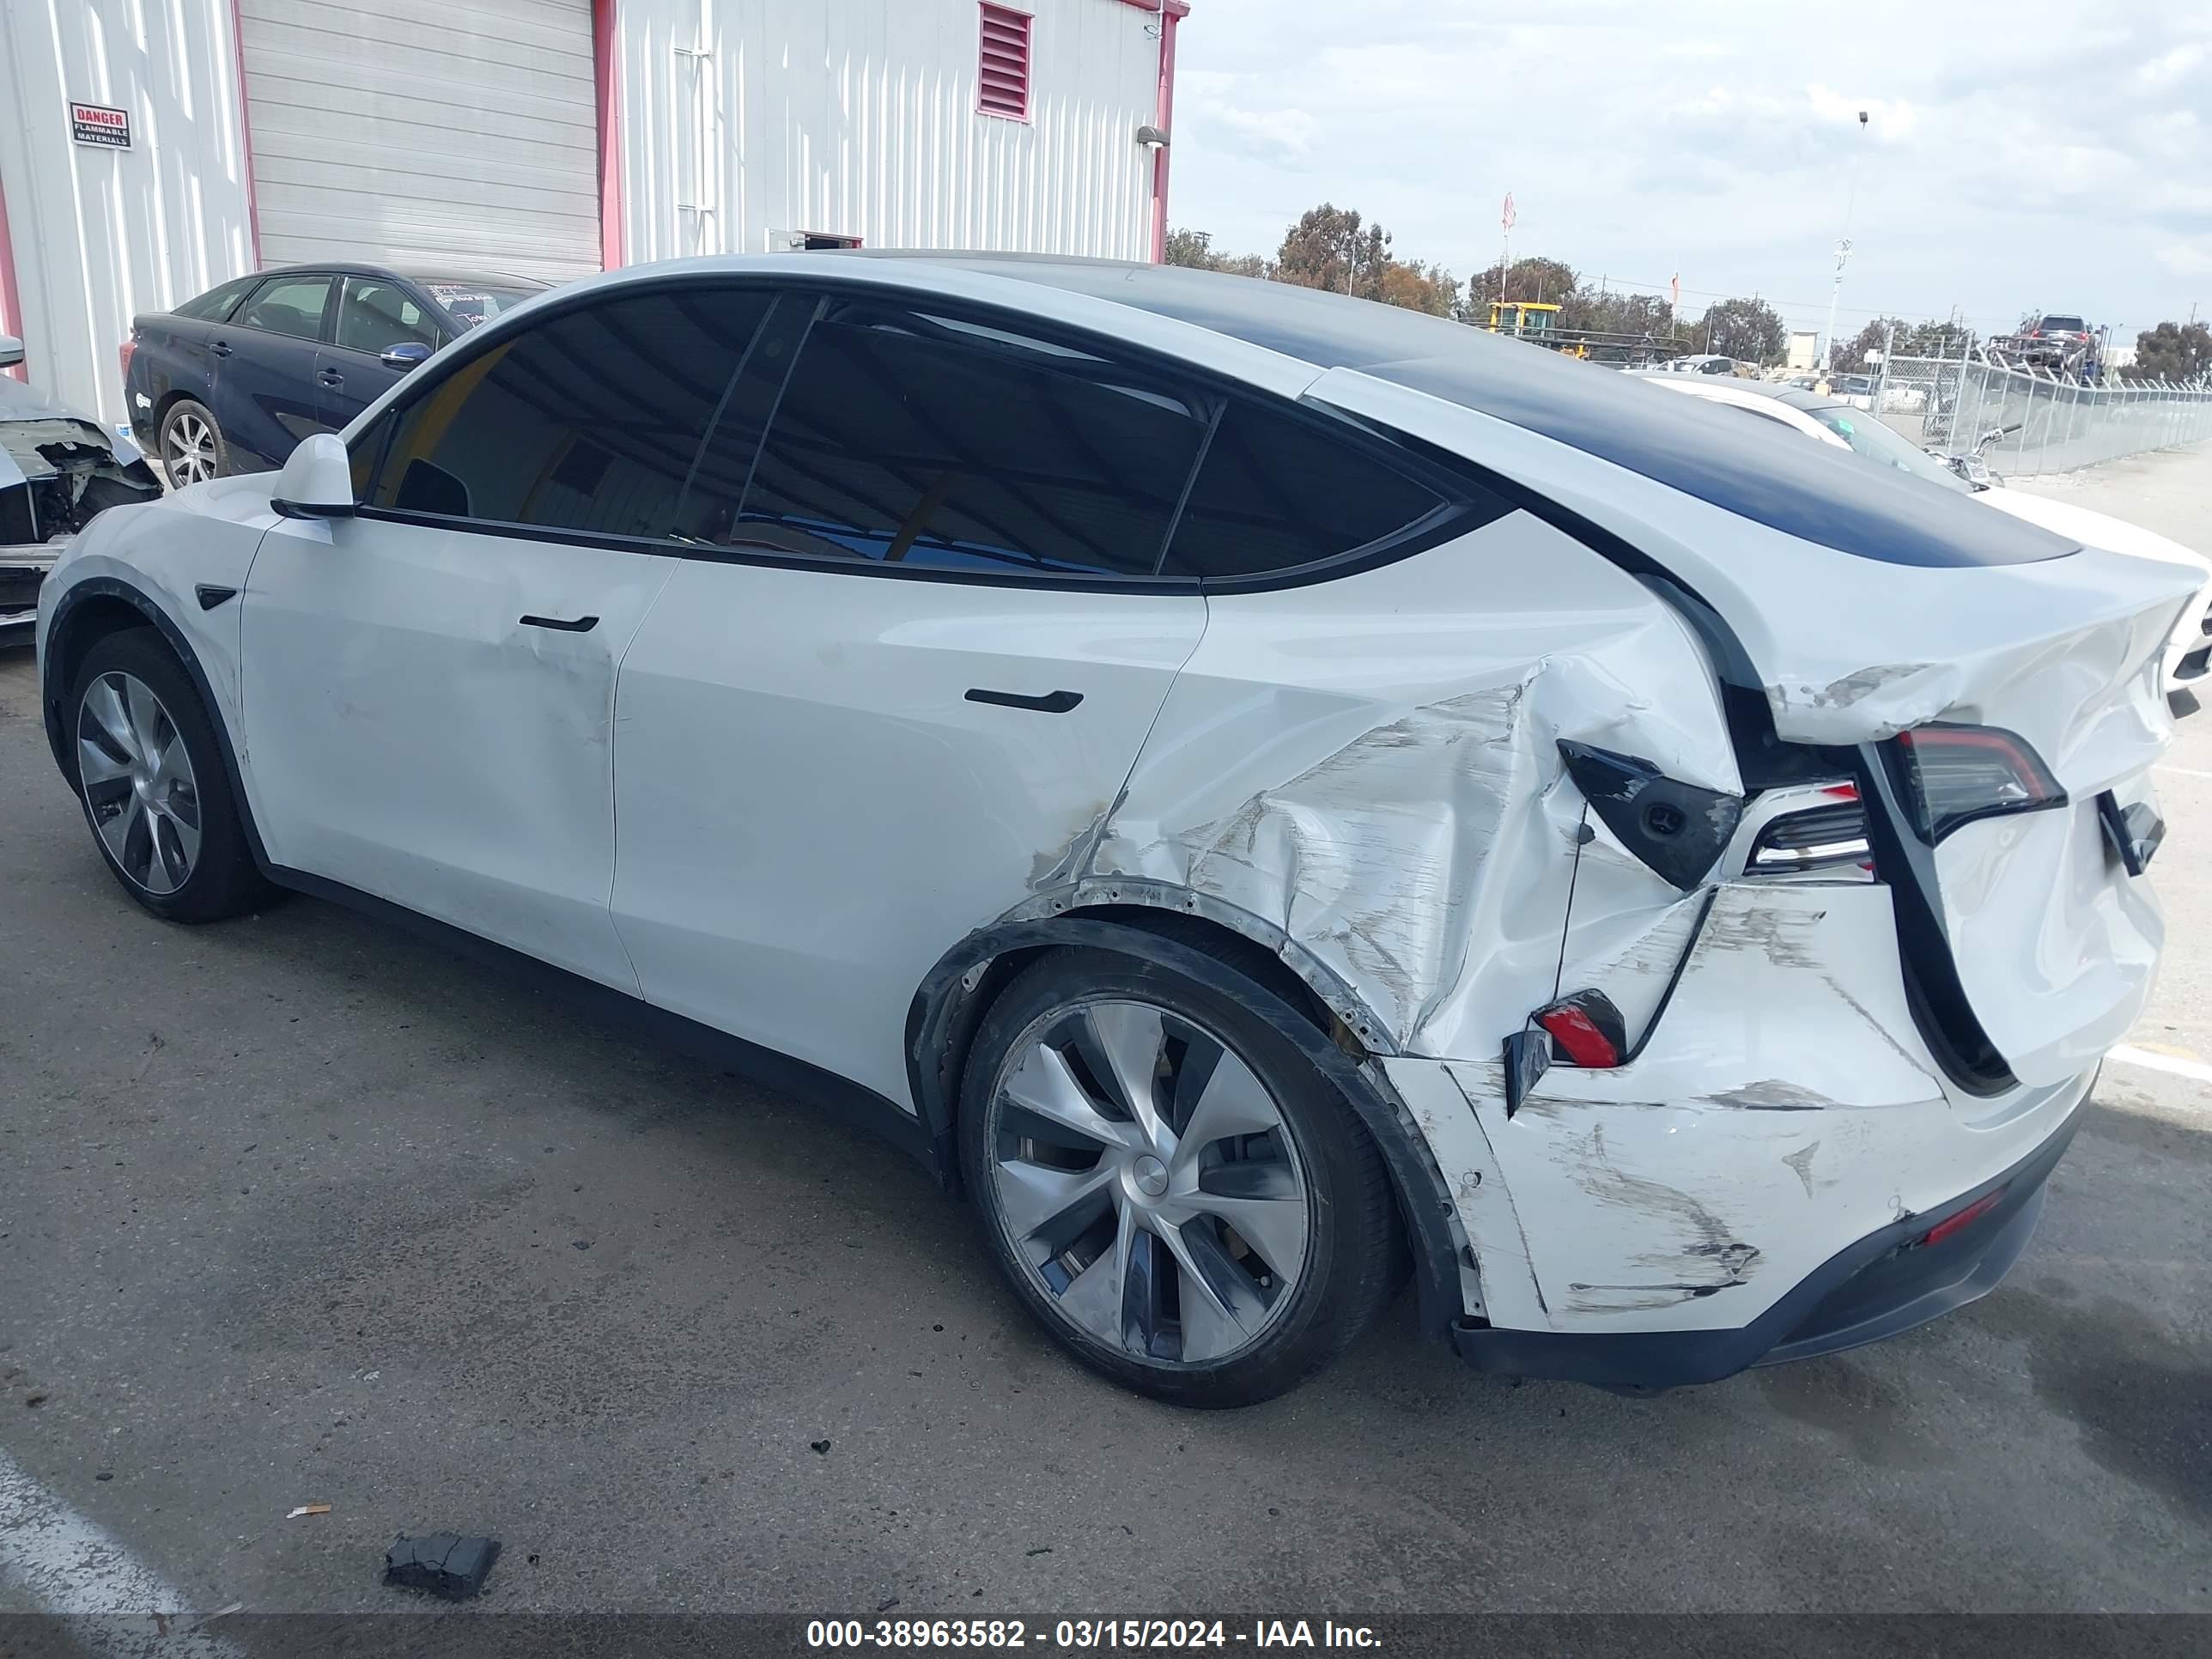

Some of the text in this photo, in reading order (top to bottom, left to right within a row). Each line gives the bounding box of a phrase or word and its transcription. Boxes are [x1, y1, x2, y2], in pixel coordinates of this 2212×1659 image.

[76, 108, 124, 126] DANGER
[74, 123, 129, 137] FLAMMABLE
[76, 132, 128, 145] MATERIALS
